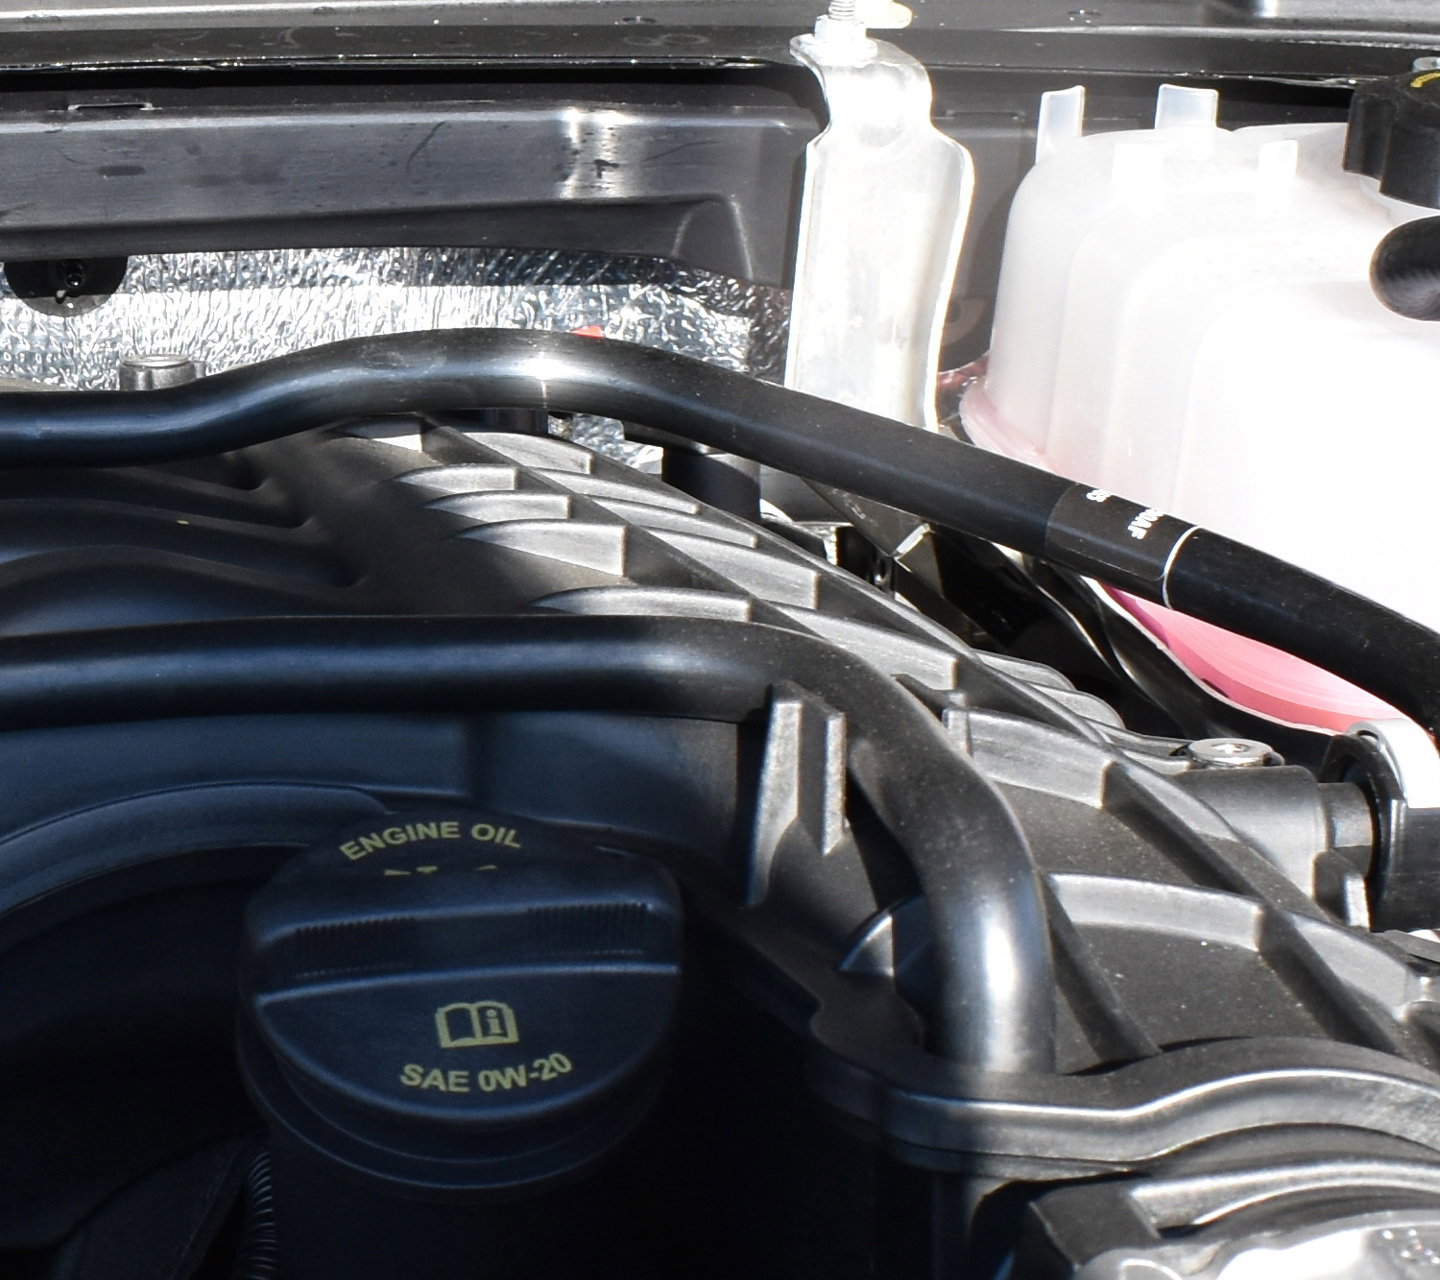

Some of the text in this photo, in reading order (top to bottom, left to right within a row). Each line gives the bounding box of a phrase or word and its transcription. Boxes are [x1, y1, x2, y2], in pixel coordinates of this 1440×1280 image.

[339, 821, 522, 861] ENGINE OIL
[400, 1052, 573, 1093] SAE 0W-20
